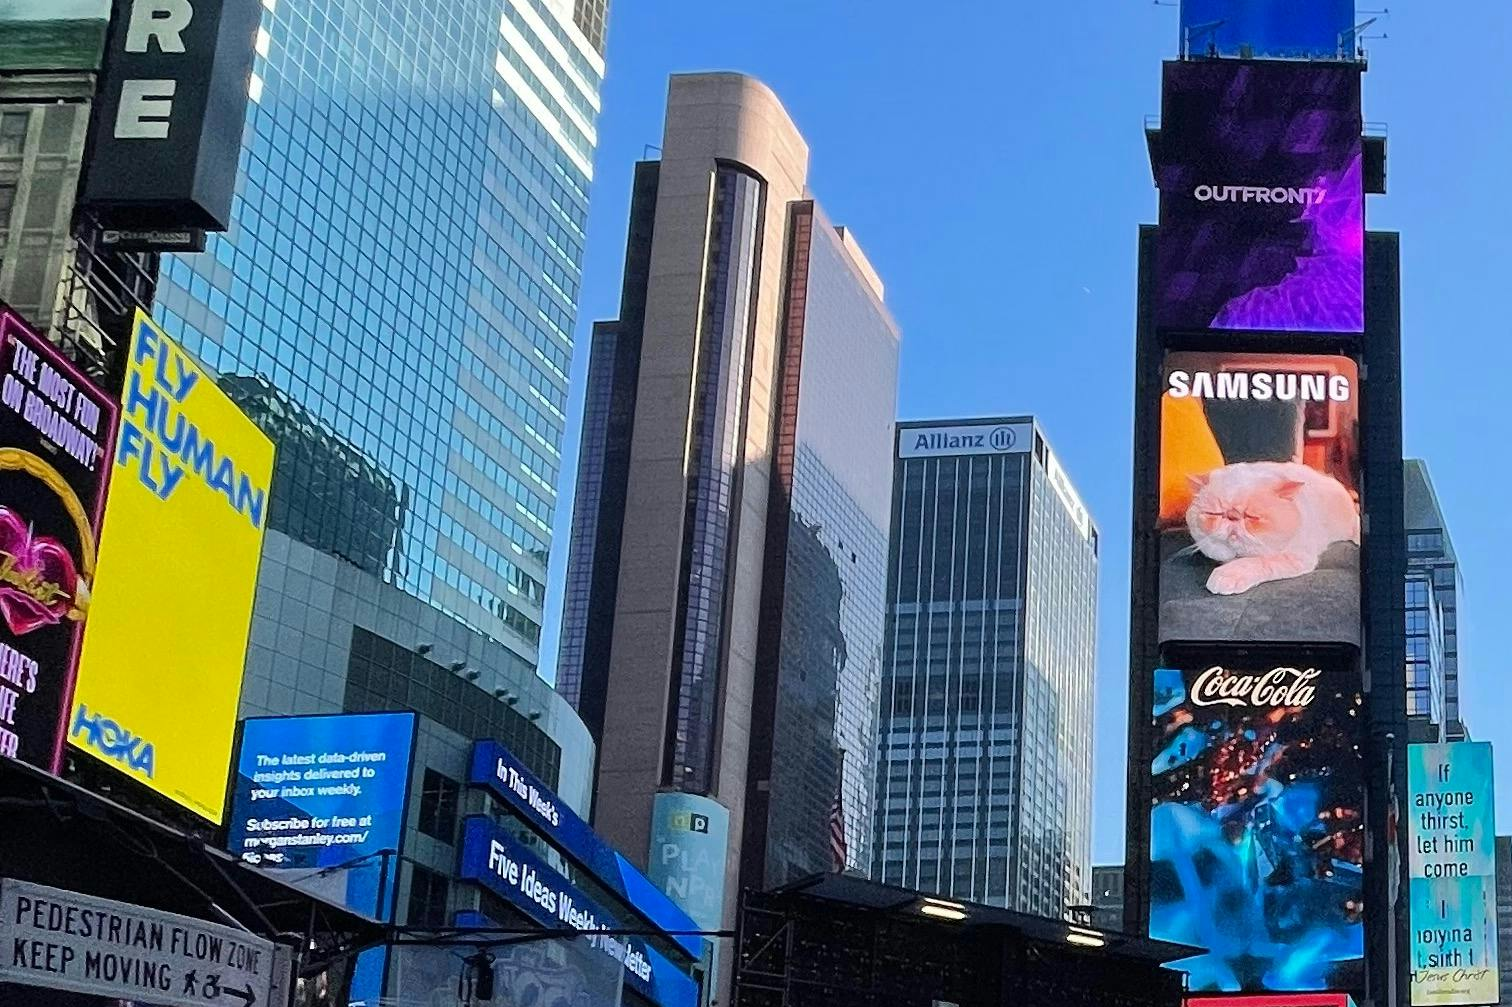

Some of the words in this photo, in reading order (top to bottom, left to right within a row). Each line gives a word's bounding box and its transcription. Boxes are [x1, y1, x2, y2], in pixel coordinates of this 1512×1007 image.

[135, 324, 198, 402] FLY
[38, 361, 76, 414] MOST
[1168, 370, 1350, 402] SAMSUNG
[127, 370, 266, 529] HUMAN
[914, 432, 984, 450] Allianz
[117, 423, 184, 500] FLY
[1191, 666, 1322, 706] Coca-Cola
[72, 705, 156, 779] HOKA
[257, 755, 279, 767] The
[282, 753, 316, 766] latest
[318, 751, 386, 764] data-driven
[253, 770, 301, 783] insights
[304, 767, 360, 780] delivered
[362, 767, 376, 778] to
[1438, 764, 1450, 783] If
[251, 788, 279, 801] your
[281, 786, 315, 798] inbox
[496, 757, 508, 783] In
[508, 767, 528, 800] This
[529, 786, 560, 827] Week's
[1415, 792, 1473, 811] anyone
[246, 817, 309, 832] Subscribe
[311, 816, 329, 829] for
[331, 815, 356, 828] free
[358, 815, 372, 827] at
[1417, 836, 1438, 854] let
[1444, 835, 1474, 852] him
[488, 839, 518, 886] Five
[521, 863, 557, 914] Ideas
[1424, 863, 1469, 878] come
[16, 896, 163, 950] PEDESTRIAN
[170, 928, 223, 963] FLOW
[227, 942, 262, 975] ZONE
[13, 937, 74, 974] KEEP
[85, 950, 172, 991] MOVING
